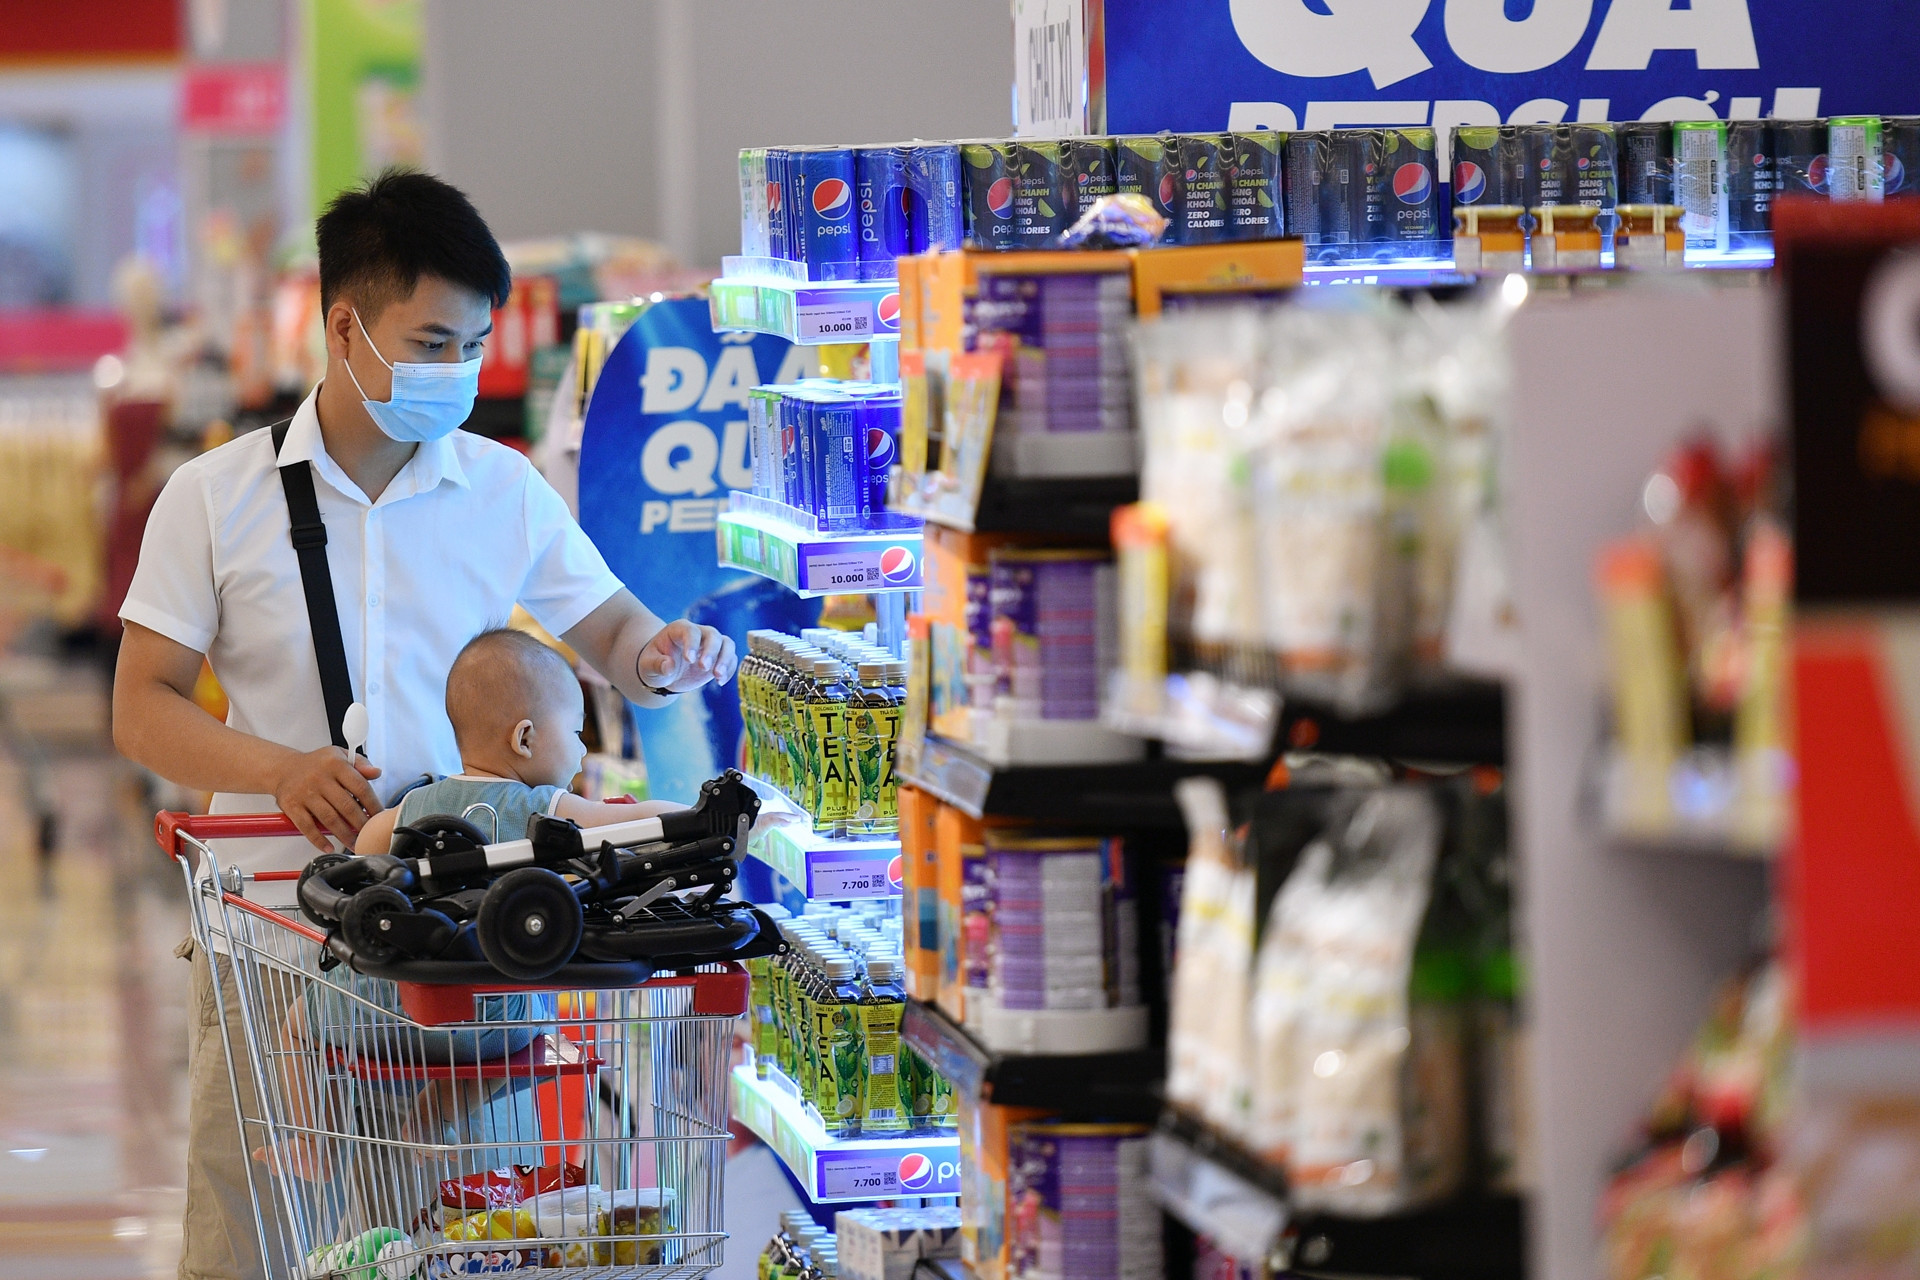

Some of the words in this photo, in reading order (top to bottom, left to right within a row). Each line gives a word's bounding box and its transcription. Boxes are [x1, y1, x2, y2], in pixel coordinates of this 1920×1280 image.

[1239, 179, 1269, 187] CHANH
[1579, 179, 1603, 188] SÁNG
[1186, 190, 1211, 199] SÁNG
[1579, 187, 1606, 197] KHOÁI
[1186, 199, 1214, 208] KHOÁI
[860, 181, 878, 242] pepsi
[1187, 211, 1210, 219] ZERO
[1397, 208, 1431, 221] pepsi
[1187, 219, 1225, 228] CALORIES
[818, 322, 852, 333] 10.000
[639, 333, 761, 414] ĐÃ
[871, 474, 889, 486] eps
[831, 574, 864, 584] 10.000
[820, 712, 842, 783] TEA
[842, 881, 869, 890] 7.700
[816, 1013, 835, 1082] TEA
[853, 1178, 881, 1188] 7.700
